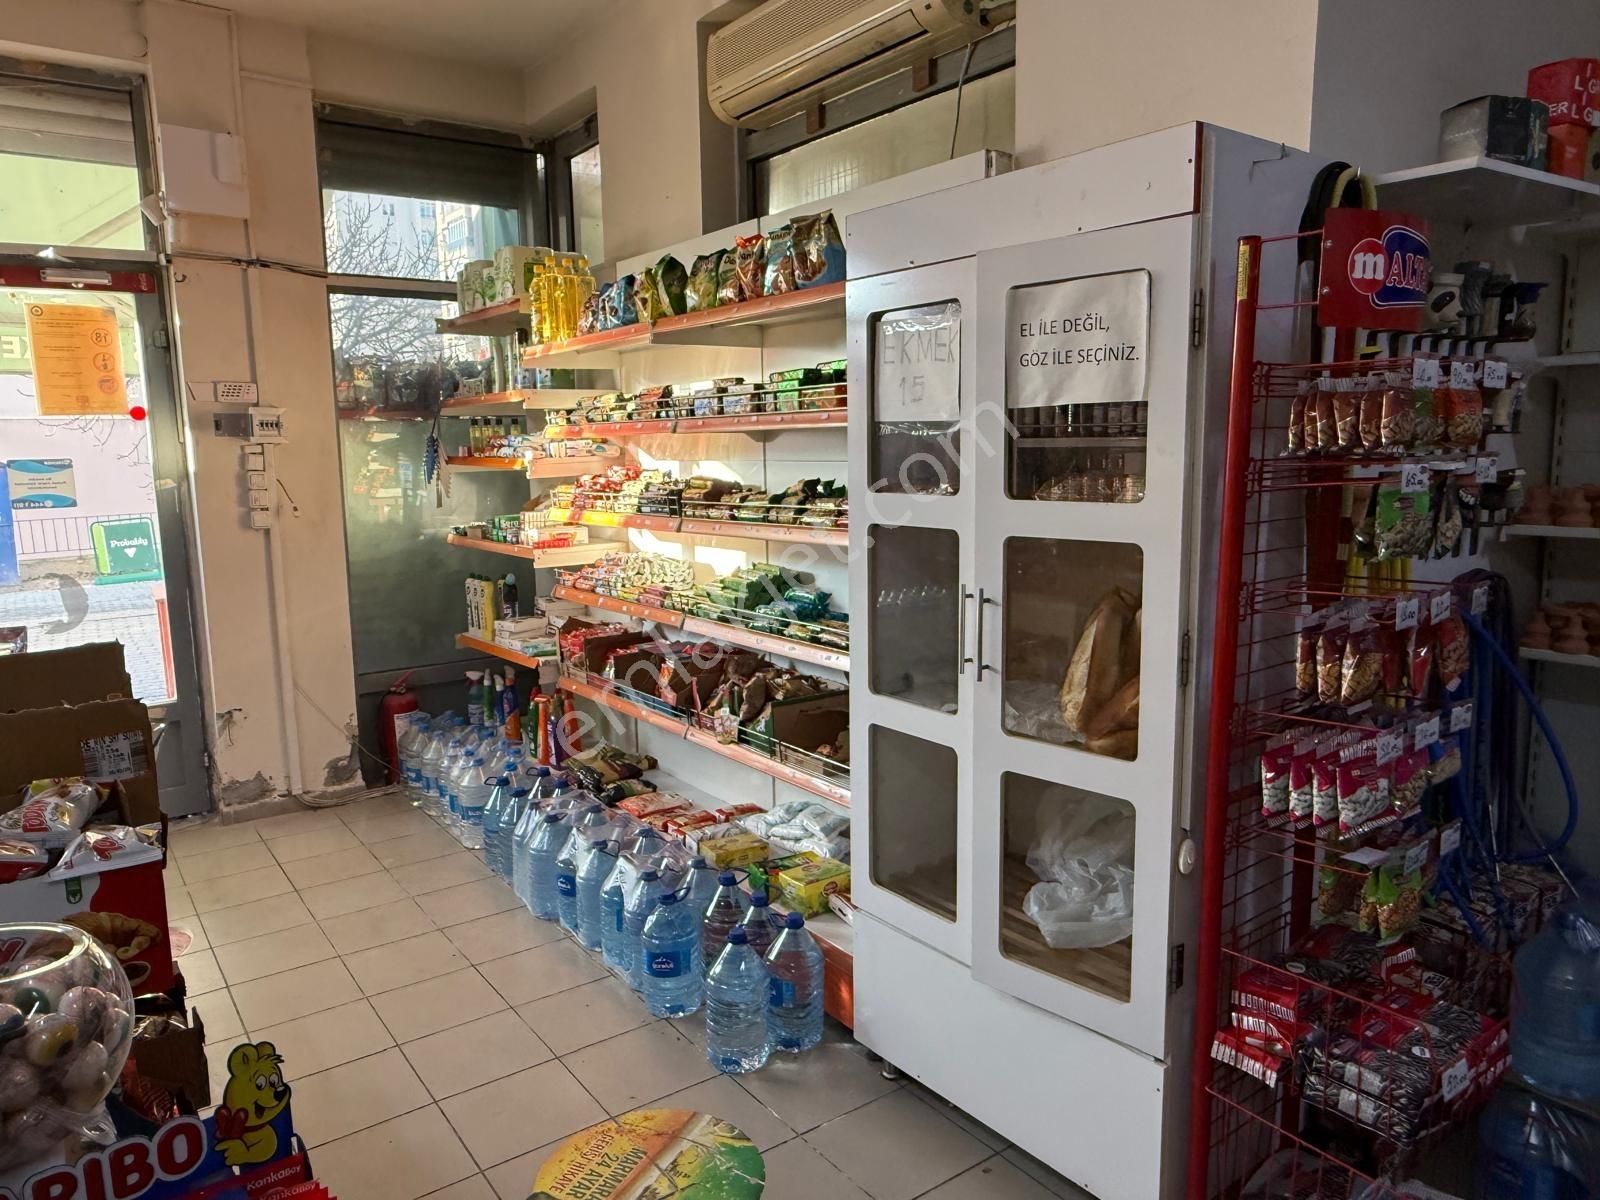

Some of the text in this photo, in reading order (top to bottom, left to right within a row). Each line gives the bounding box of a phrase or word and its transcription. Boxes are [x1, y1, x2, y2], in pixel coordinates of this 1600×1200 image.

[1020, 312, 1110, 337] EL İLE DEĞİL,
[882, 329, 959, 365] EKMEK
[1019, 342, 1140, 368] GÖZ İLE SEÇİNİZ.
[898, 375, 926, 406] 15
[0, 1121, 204, 1200] RIBO
[565, 1152, 620, 1200] 24 AYAR
